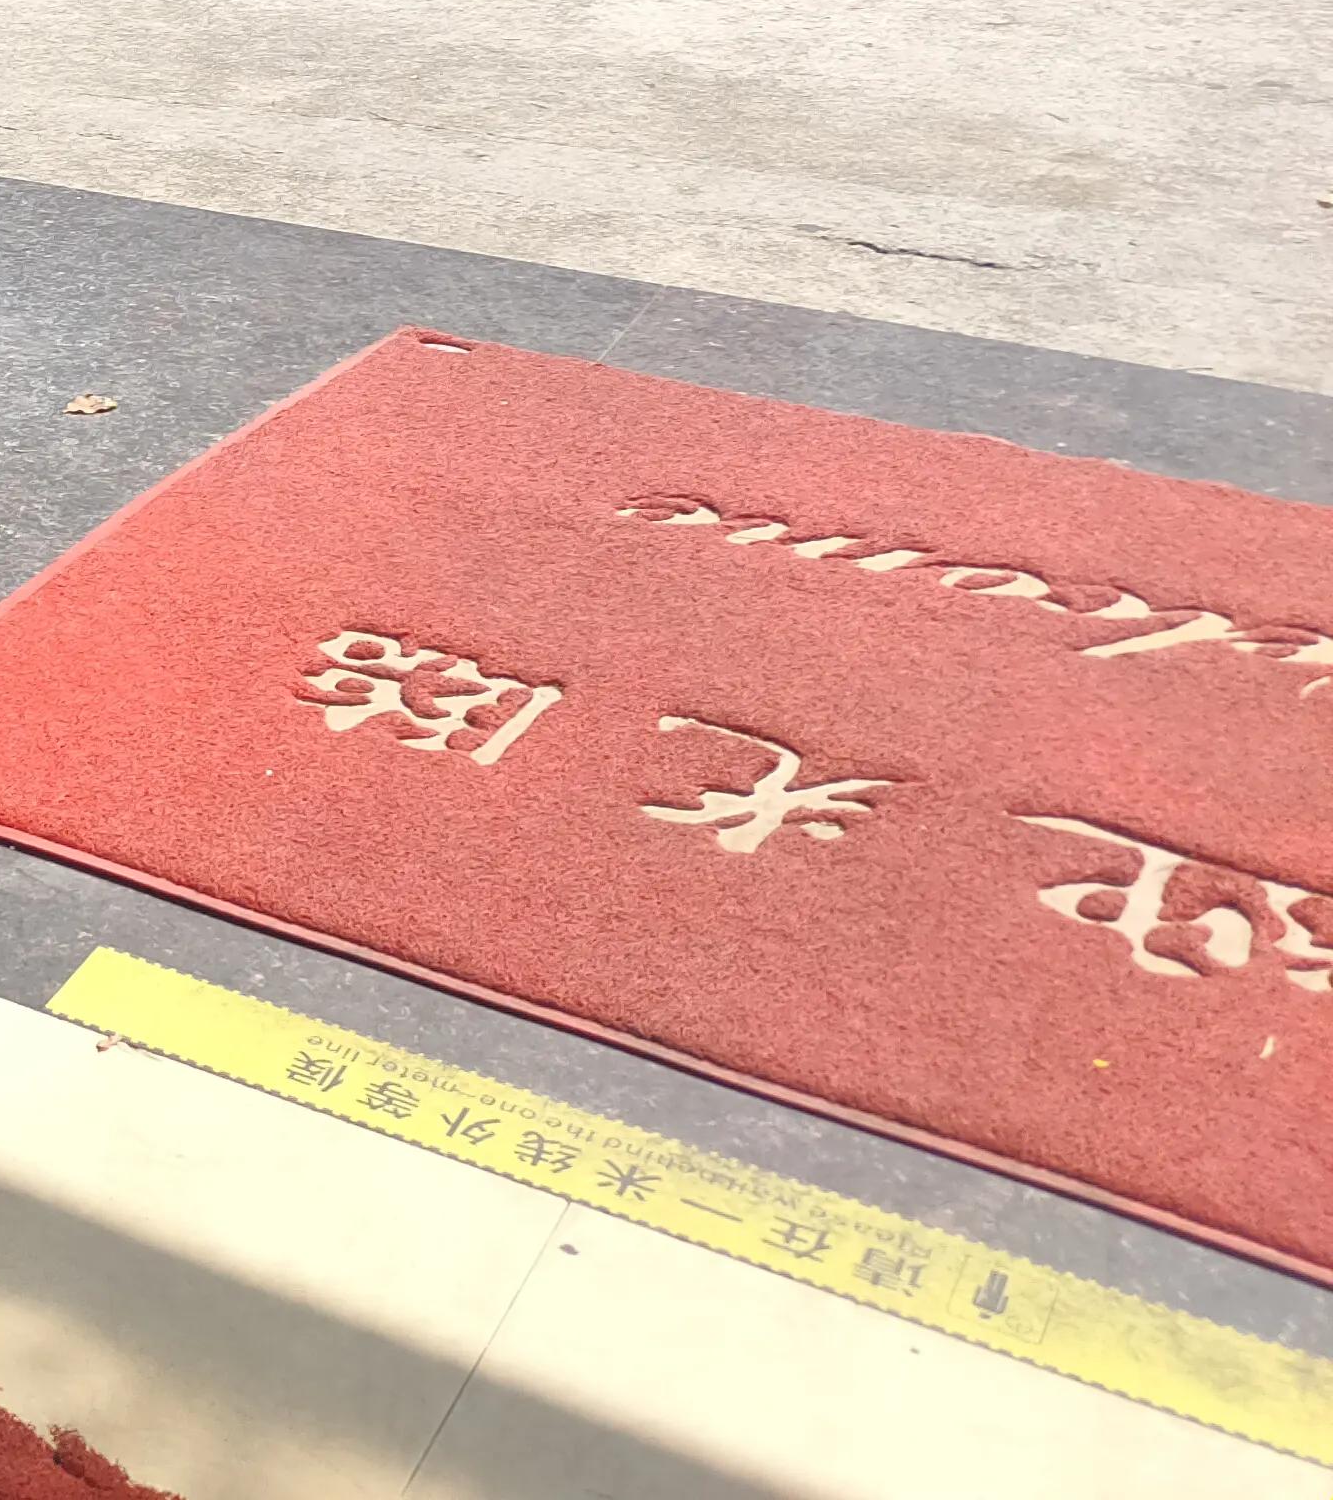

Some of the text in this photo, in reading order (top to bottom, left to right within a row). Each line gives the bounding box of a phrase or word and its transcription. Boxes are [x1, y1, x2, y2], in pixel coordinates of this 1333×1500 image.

[614, 496, 1333, 698] elcome
[305, 1032, 362, 1064] line
[285, 1048, 927, 1300] 请在一米线外等候
[542, 1112, 597, 1145] the
